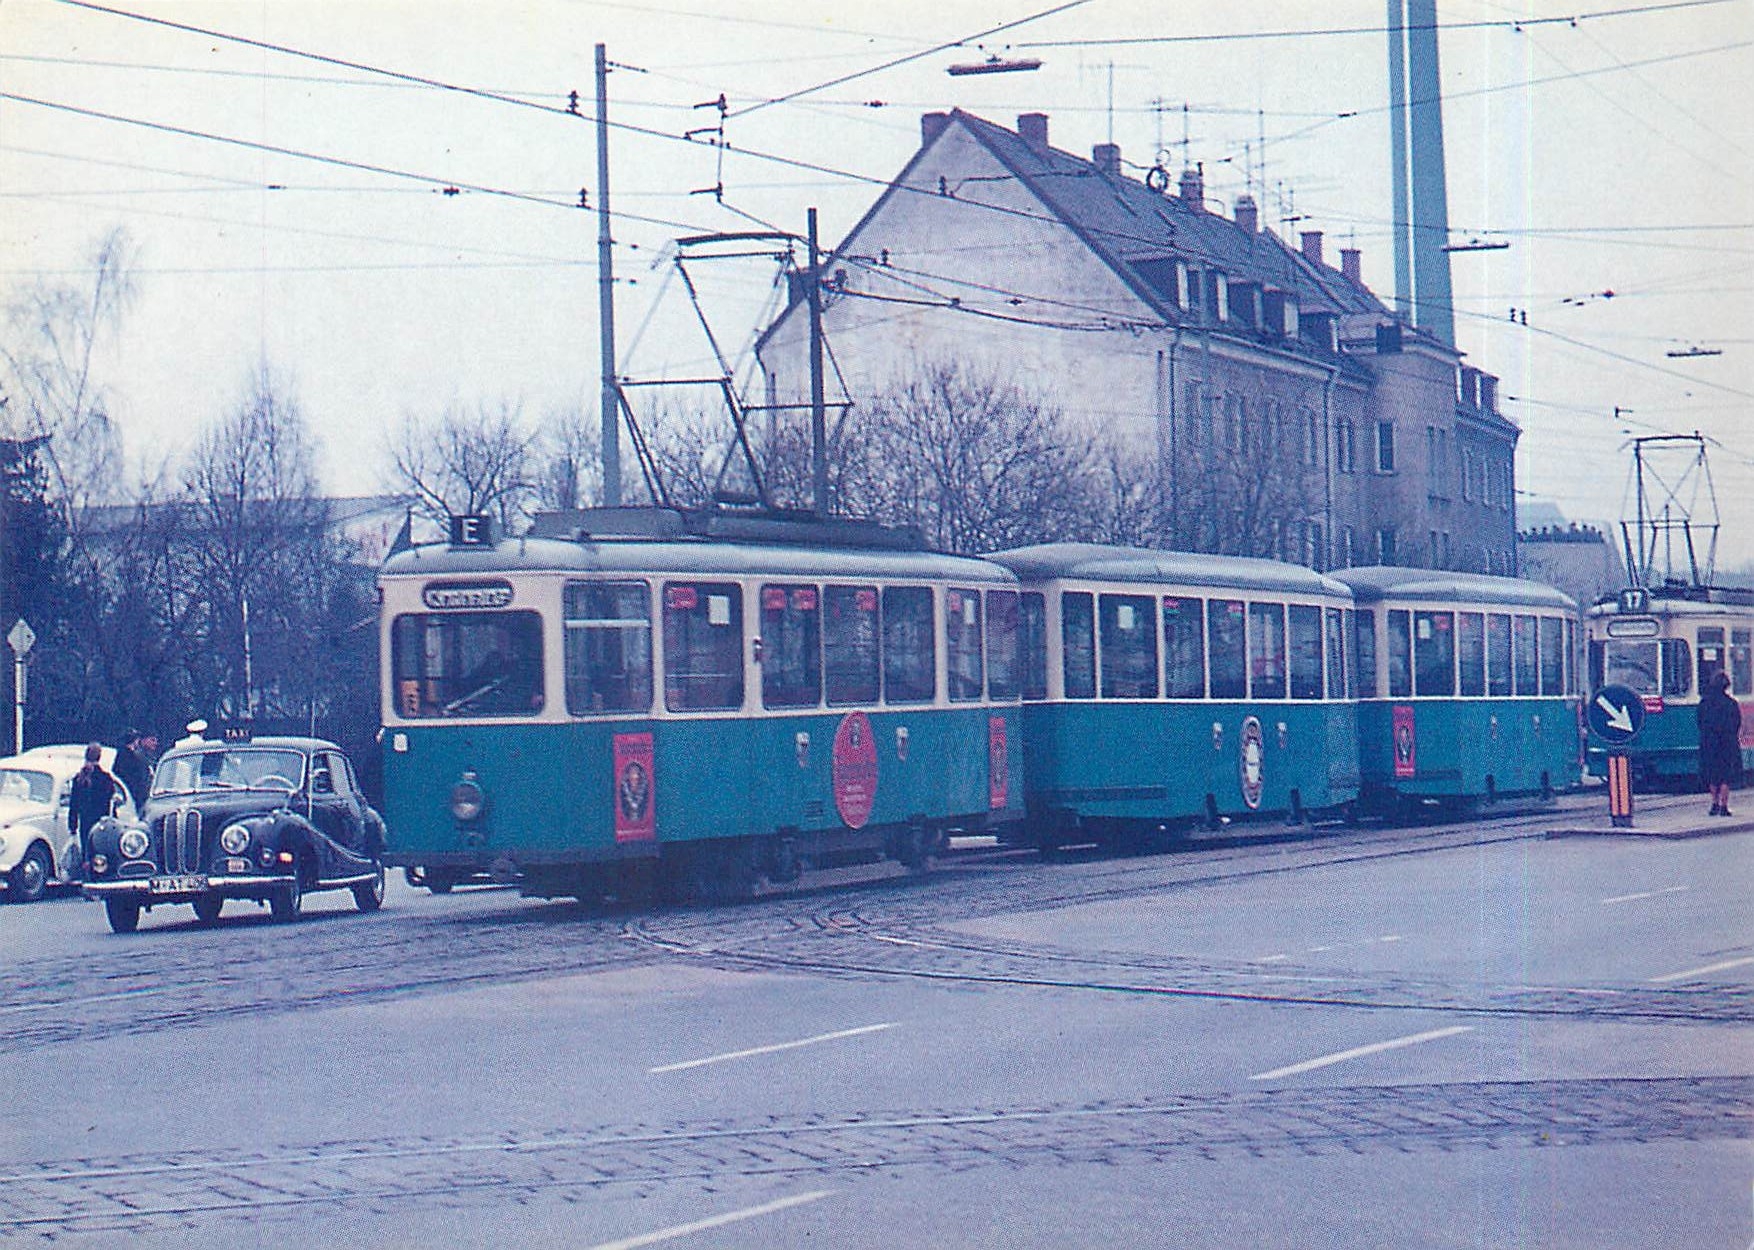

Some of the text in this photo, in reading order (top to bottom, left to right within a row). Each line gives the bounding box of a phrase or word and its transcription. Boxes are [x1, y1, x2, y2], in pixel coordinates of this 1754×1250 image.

[462, 518, 480, 543] E
[1625, 591, 1643, 609] 17
[225, 729, 250, 739] TAXI
